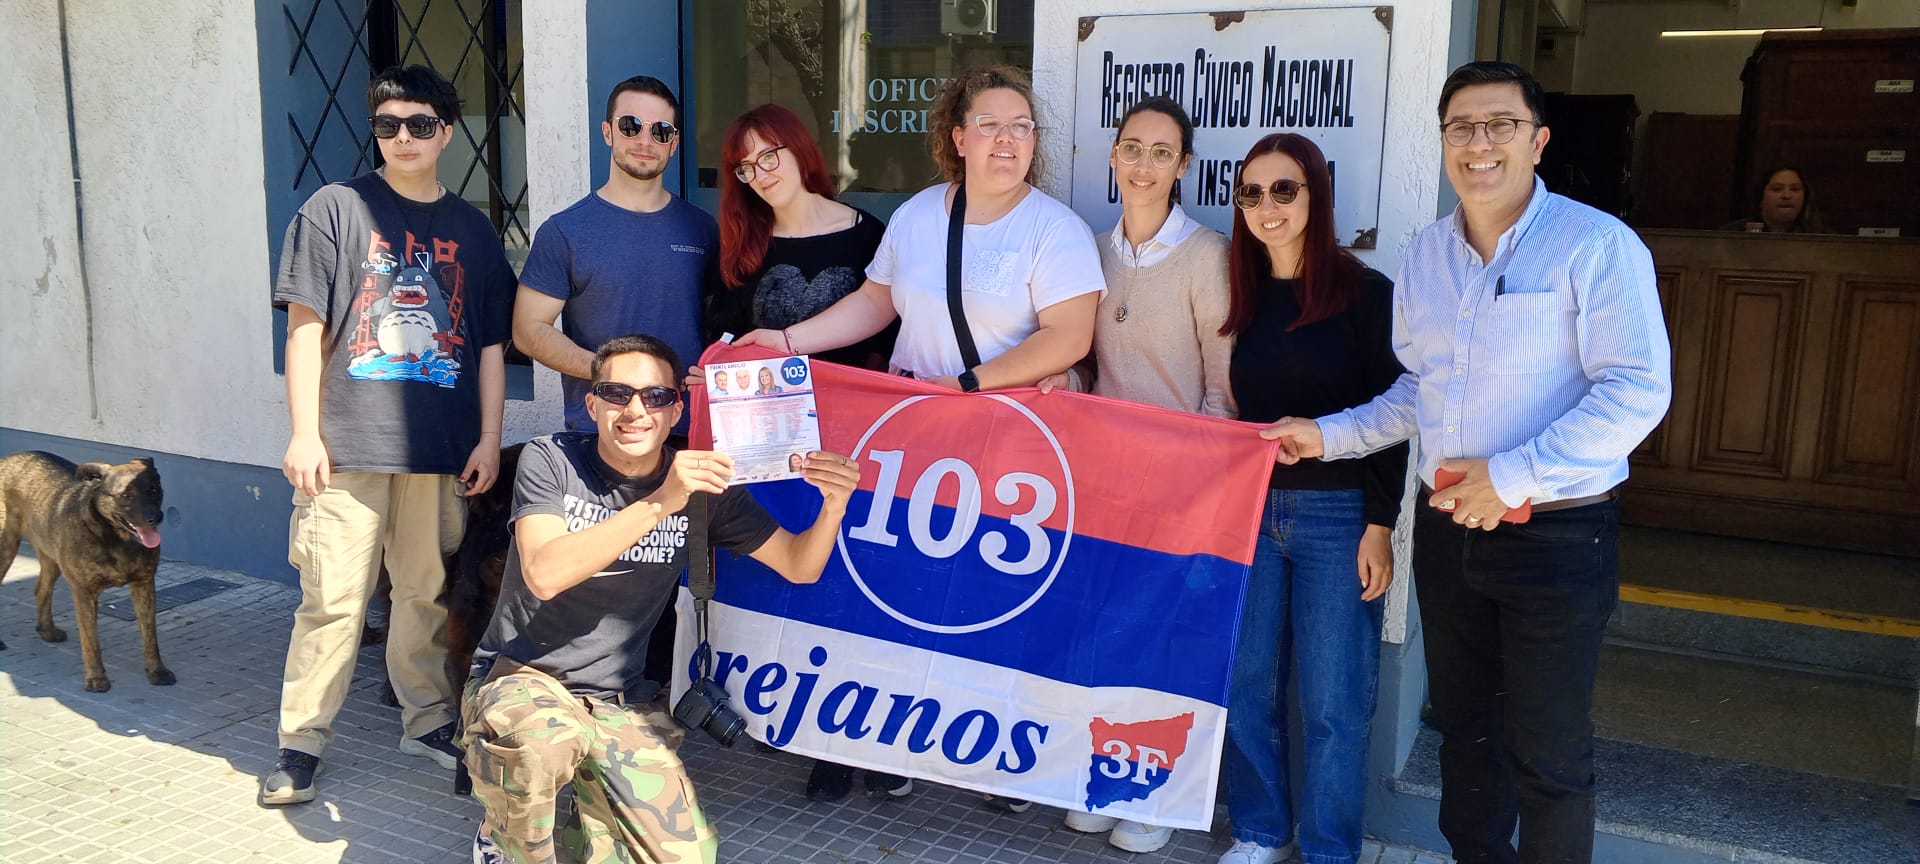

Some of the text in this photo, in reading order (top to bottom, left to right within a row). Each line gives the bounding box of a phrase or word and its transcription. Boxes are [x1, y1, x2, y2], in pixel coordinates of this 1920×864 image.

[868, 78, 957, 102] OFIC
[1260, 45, 1354, 128] NACIONAL
[832, 110, 928, 133] INSCRI
[783, 366, 806, 378] 103
[849, 449, 1057, 575] 103
[1099, 740, 1168, 786] 3F
